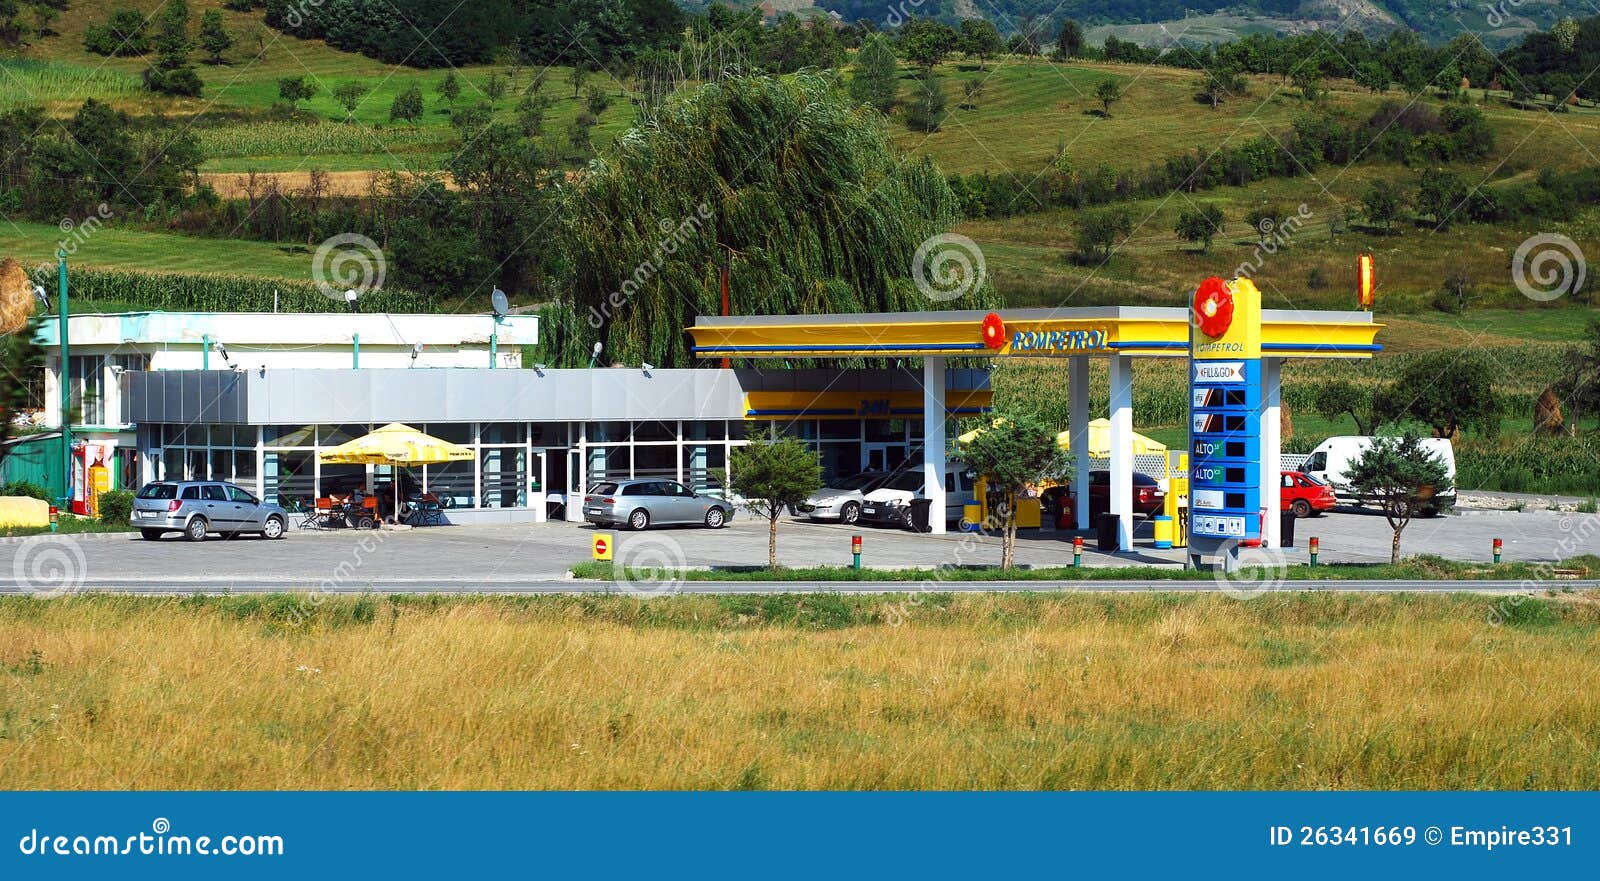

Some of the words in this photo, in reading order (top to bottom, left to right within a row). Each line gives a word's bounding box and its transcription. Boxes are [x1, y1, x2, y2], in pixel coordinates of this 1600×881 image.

[1012, 329, 1108, 350] ROMPETROL
[1203, 367, 1231, 378] FILL&GO
[1195, 443, 1214, 454] ALTO
[1195, 469, 1214, 480] ALTO
